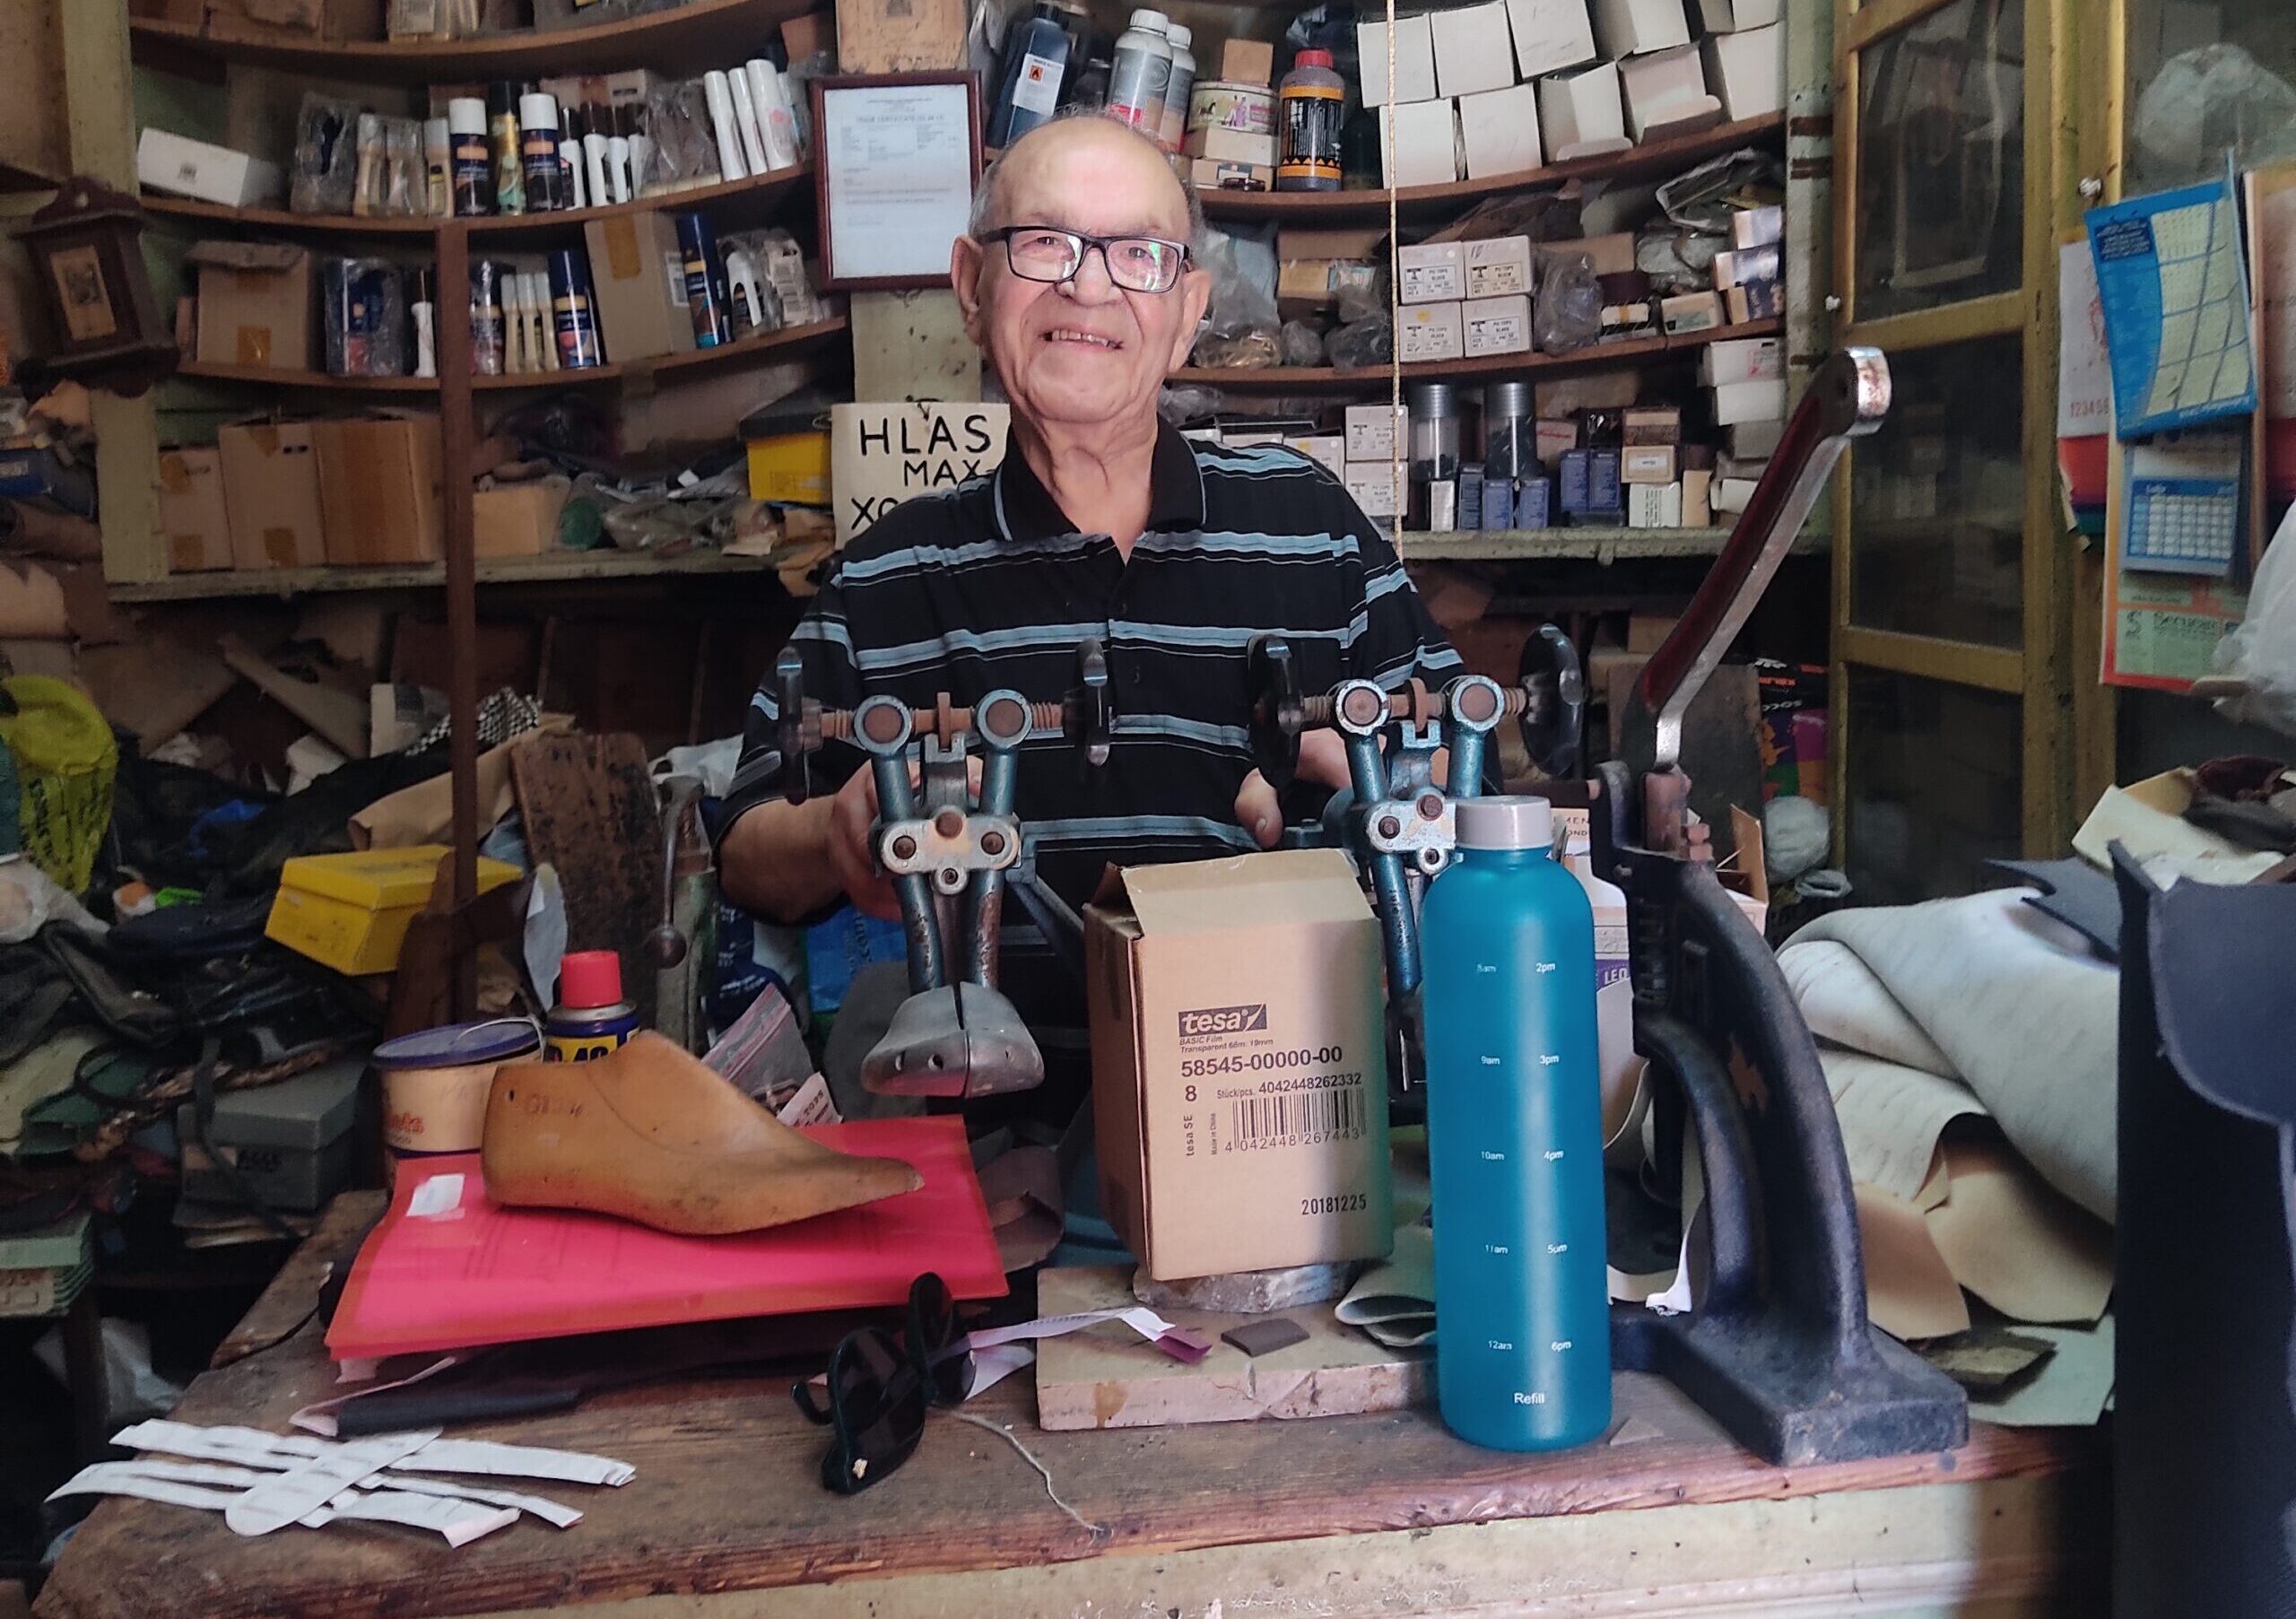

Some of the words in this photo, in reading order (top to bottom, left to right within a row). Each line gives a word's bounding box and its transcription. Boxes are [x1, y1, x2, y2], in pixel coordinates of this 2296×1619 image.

[860, 414, 991, 457] HLAS
[904, 459, 980, 487] MAX
[1535, 962, 1556, 974] 2pm
[1181, 1011, 1242, 1034] tesa
[1179, 1037, 1204, 1046] BASIC
[1205, 1035, 1222, 1043] Film
[1180, 1043, 1227, 1055] Transparent
[1181, 1046, 1343, 1078] 58545-00000-00
[1481, 1056, 1500, 1065] 9am
[1539, 1054, 1560, 1066] 3pm
[1258, 1073, 1362, 1094] 4042448262332
[1185, 1084, 1197, 1101] 8
[1217, 1087, 1256, 1099] Stück/pcs.
[1183, 1115, 1193, 1129] SE
[1186, 1132, 1195, 1156] tesa
[1225, 1142, 1232, 1153] 4
[1481, 1151, 1505, 1160] 10am
[1544, 1150, 1564, 1162] 4pm
[1301, 1194, 1367, 1215] 20181225
[1485, 1244, 1509, 1254] 11am
[1488, 1340, 1512, 1351] 12am
[1551, 1341, 1572, 1352] 6pm
[1514, 1392, 1544, 1405] Refill
